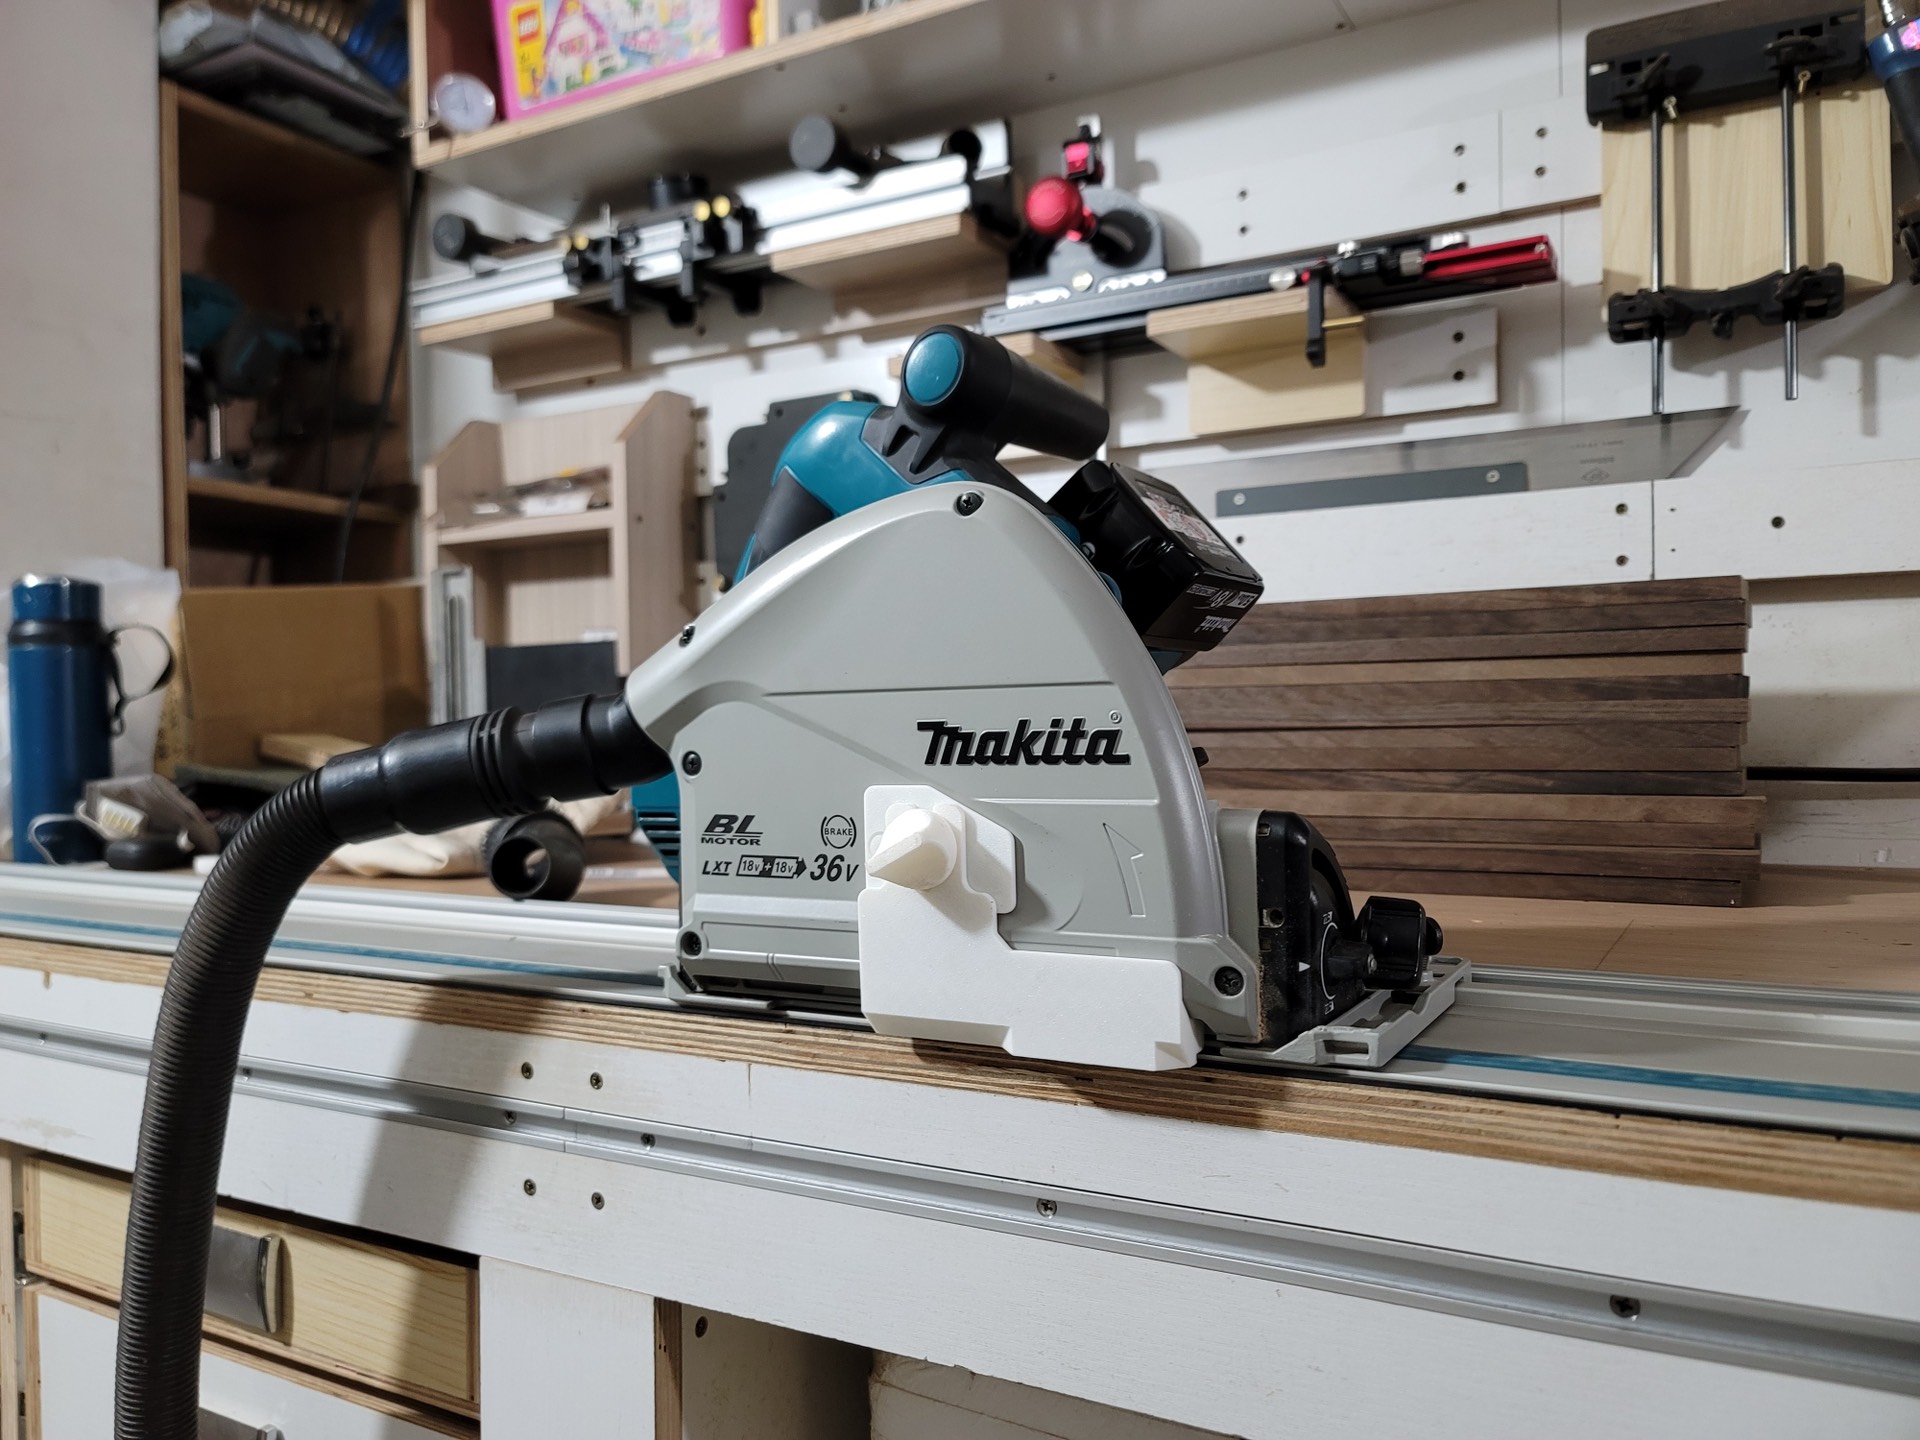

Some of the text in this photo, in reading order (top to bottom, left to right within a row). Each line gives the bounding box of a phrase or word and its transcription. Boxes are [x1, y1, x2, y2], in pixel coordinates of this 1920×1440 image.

[703, 813, 764, 837] BL
[824, 827, 853, 836] BRAKE
[701, 836, 761, 846] MOTOR
[702, 860, 732, 876] LXT
